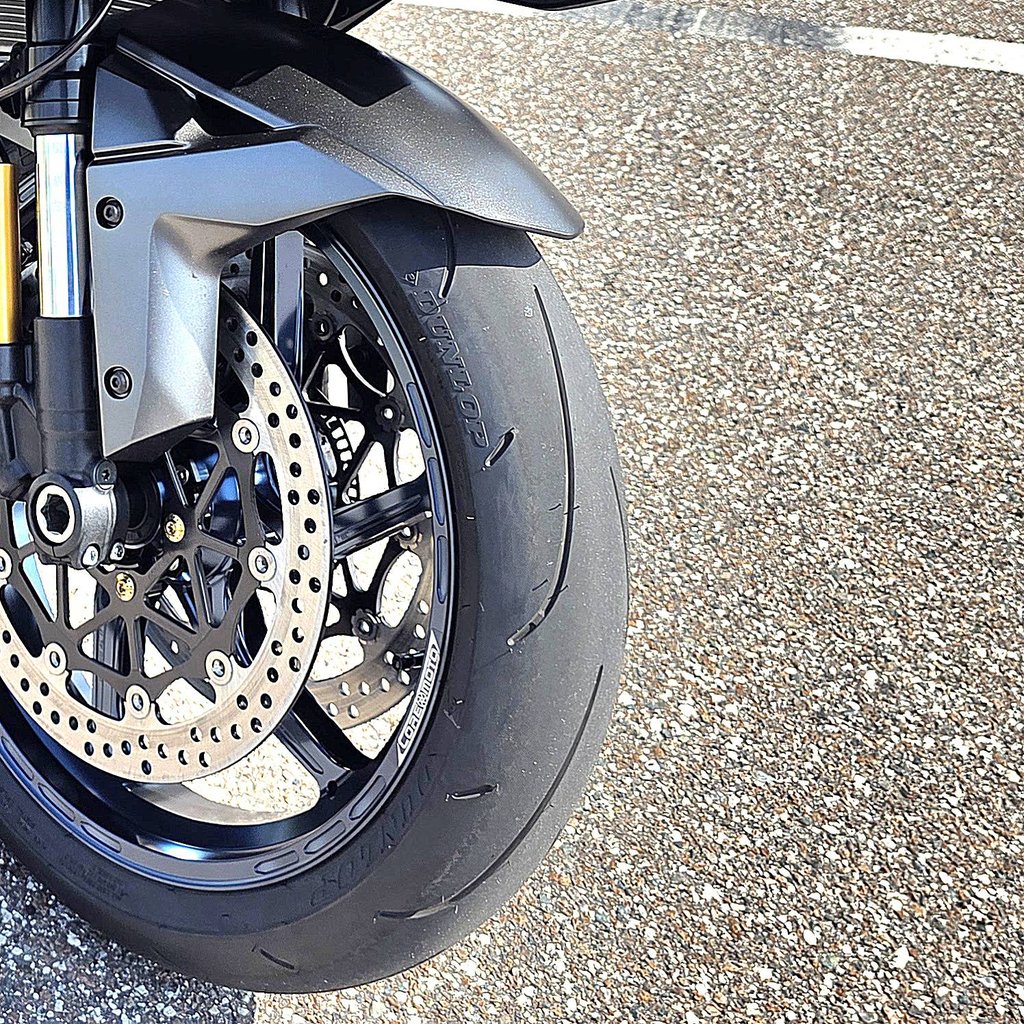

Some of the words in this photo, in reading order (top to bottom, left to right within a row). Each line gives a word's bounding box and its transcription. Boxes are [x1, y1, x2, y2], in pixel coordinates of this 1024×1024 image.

[413, 289, 490, 448] DUNLOP
[397, 703, 426, 750] CORE
[421, 647, 440, 696] MOTO
